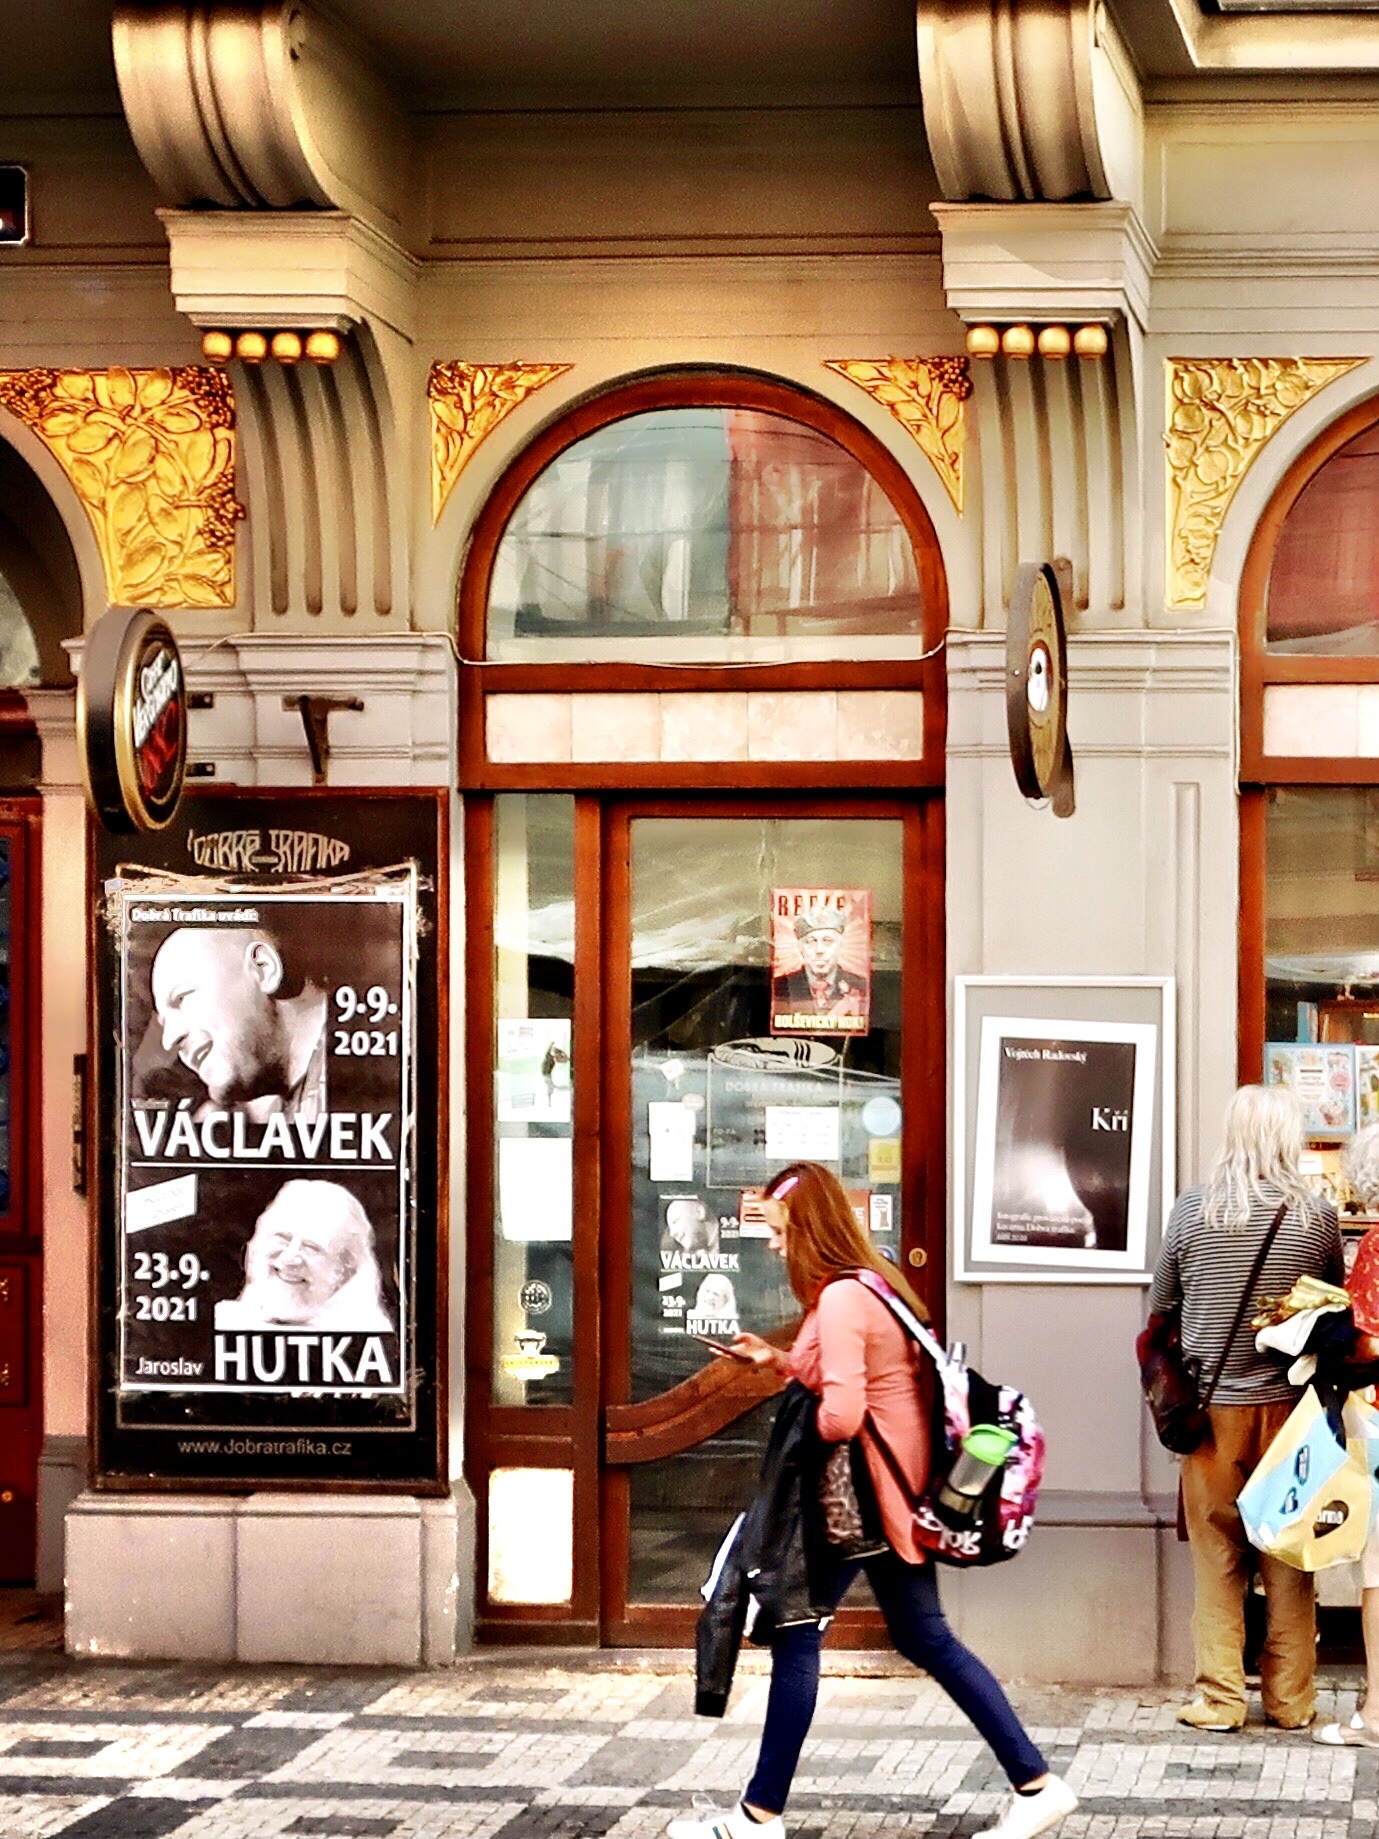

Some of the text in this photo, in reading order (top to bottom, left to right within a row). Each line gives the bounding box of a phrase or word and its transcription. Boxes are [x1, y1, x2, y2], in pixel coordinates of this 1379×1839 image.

[334, 985, 399, 1024] 9.9.
[334, 1030, 398, 1057] 2021
[133, 1098, 394, 1160] VÁCLAVEK
[134, 1251, 210, 1290] 23.9.
[660, 1250, 740, 1269] VÁCLAVEK
[135, 1296, 198, 1322] 2021
[686, 1319, 740, 1335] HUTKA
[135, 1334, 393, 1383] Jaroslav HUTKA
[177, 1438, 352, 1456] www.dobratrafika.cz
